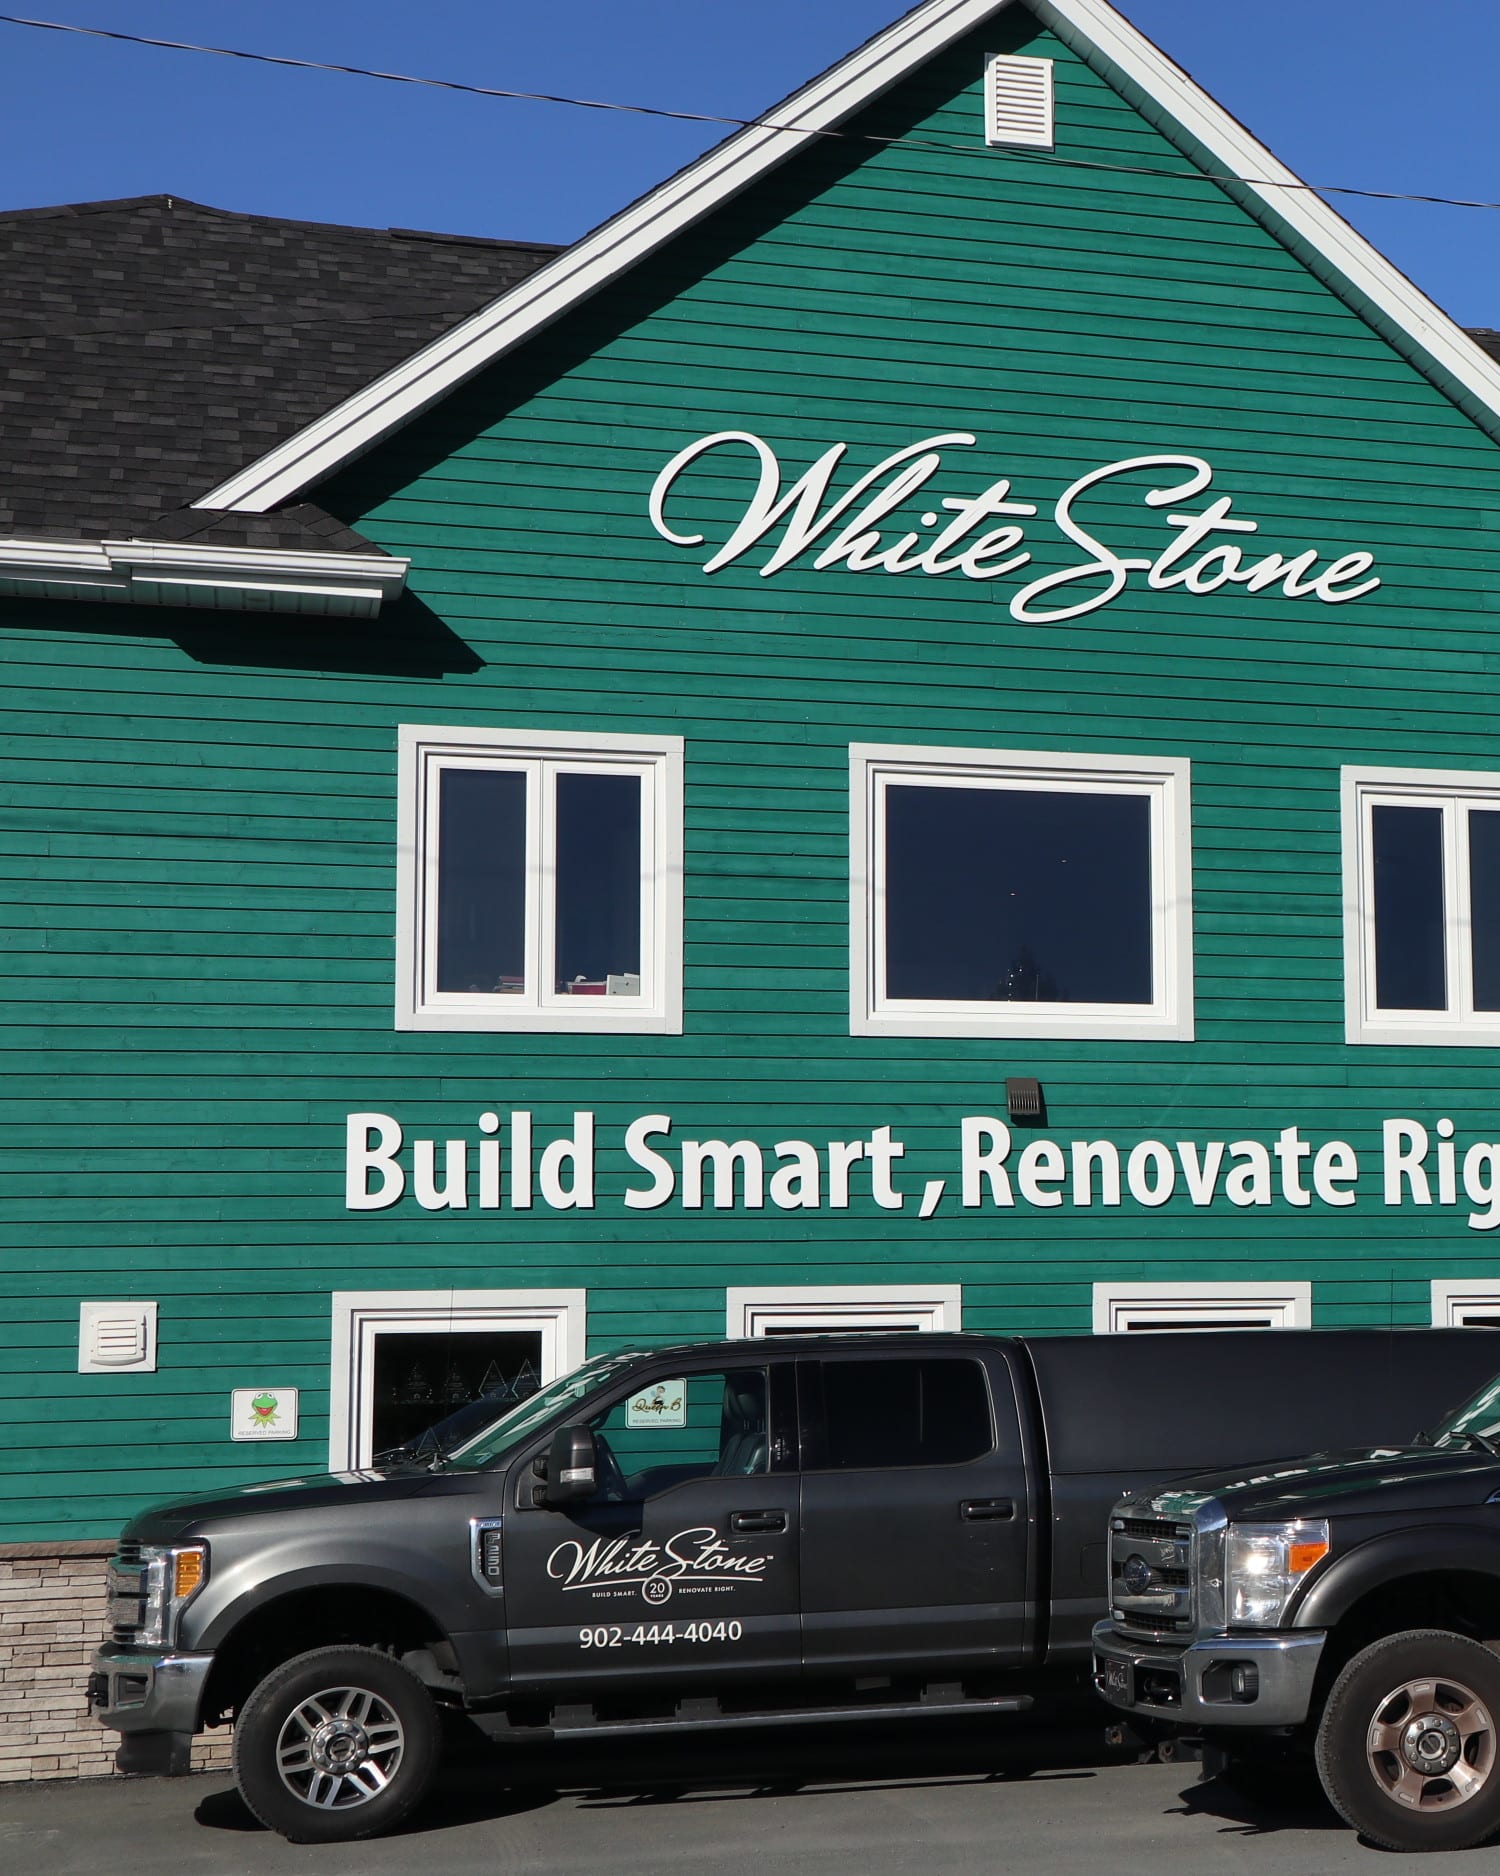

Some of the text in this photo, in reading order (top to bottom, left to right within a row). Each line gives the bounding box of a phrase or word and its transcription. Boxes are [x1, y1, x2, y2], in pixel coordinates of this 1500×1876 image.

[346, 1112, 593, 1210] Build
[961, 1117, 1357, 1208] Renovate
[649, 1582, 665, 1594] 20
[678, 1587, 713, 1595] RENOVATE
[592, 1591, 611, 1599] BUILD
[579, 1621, 742, 1649] 902-444-4040
